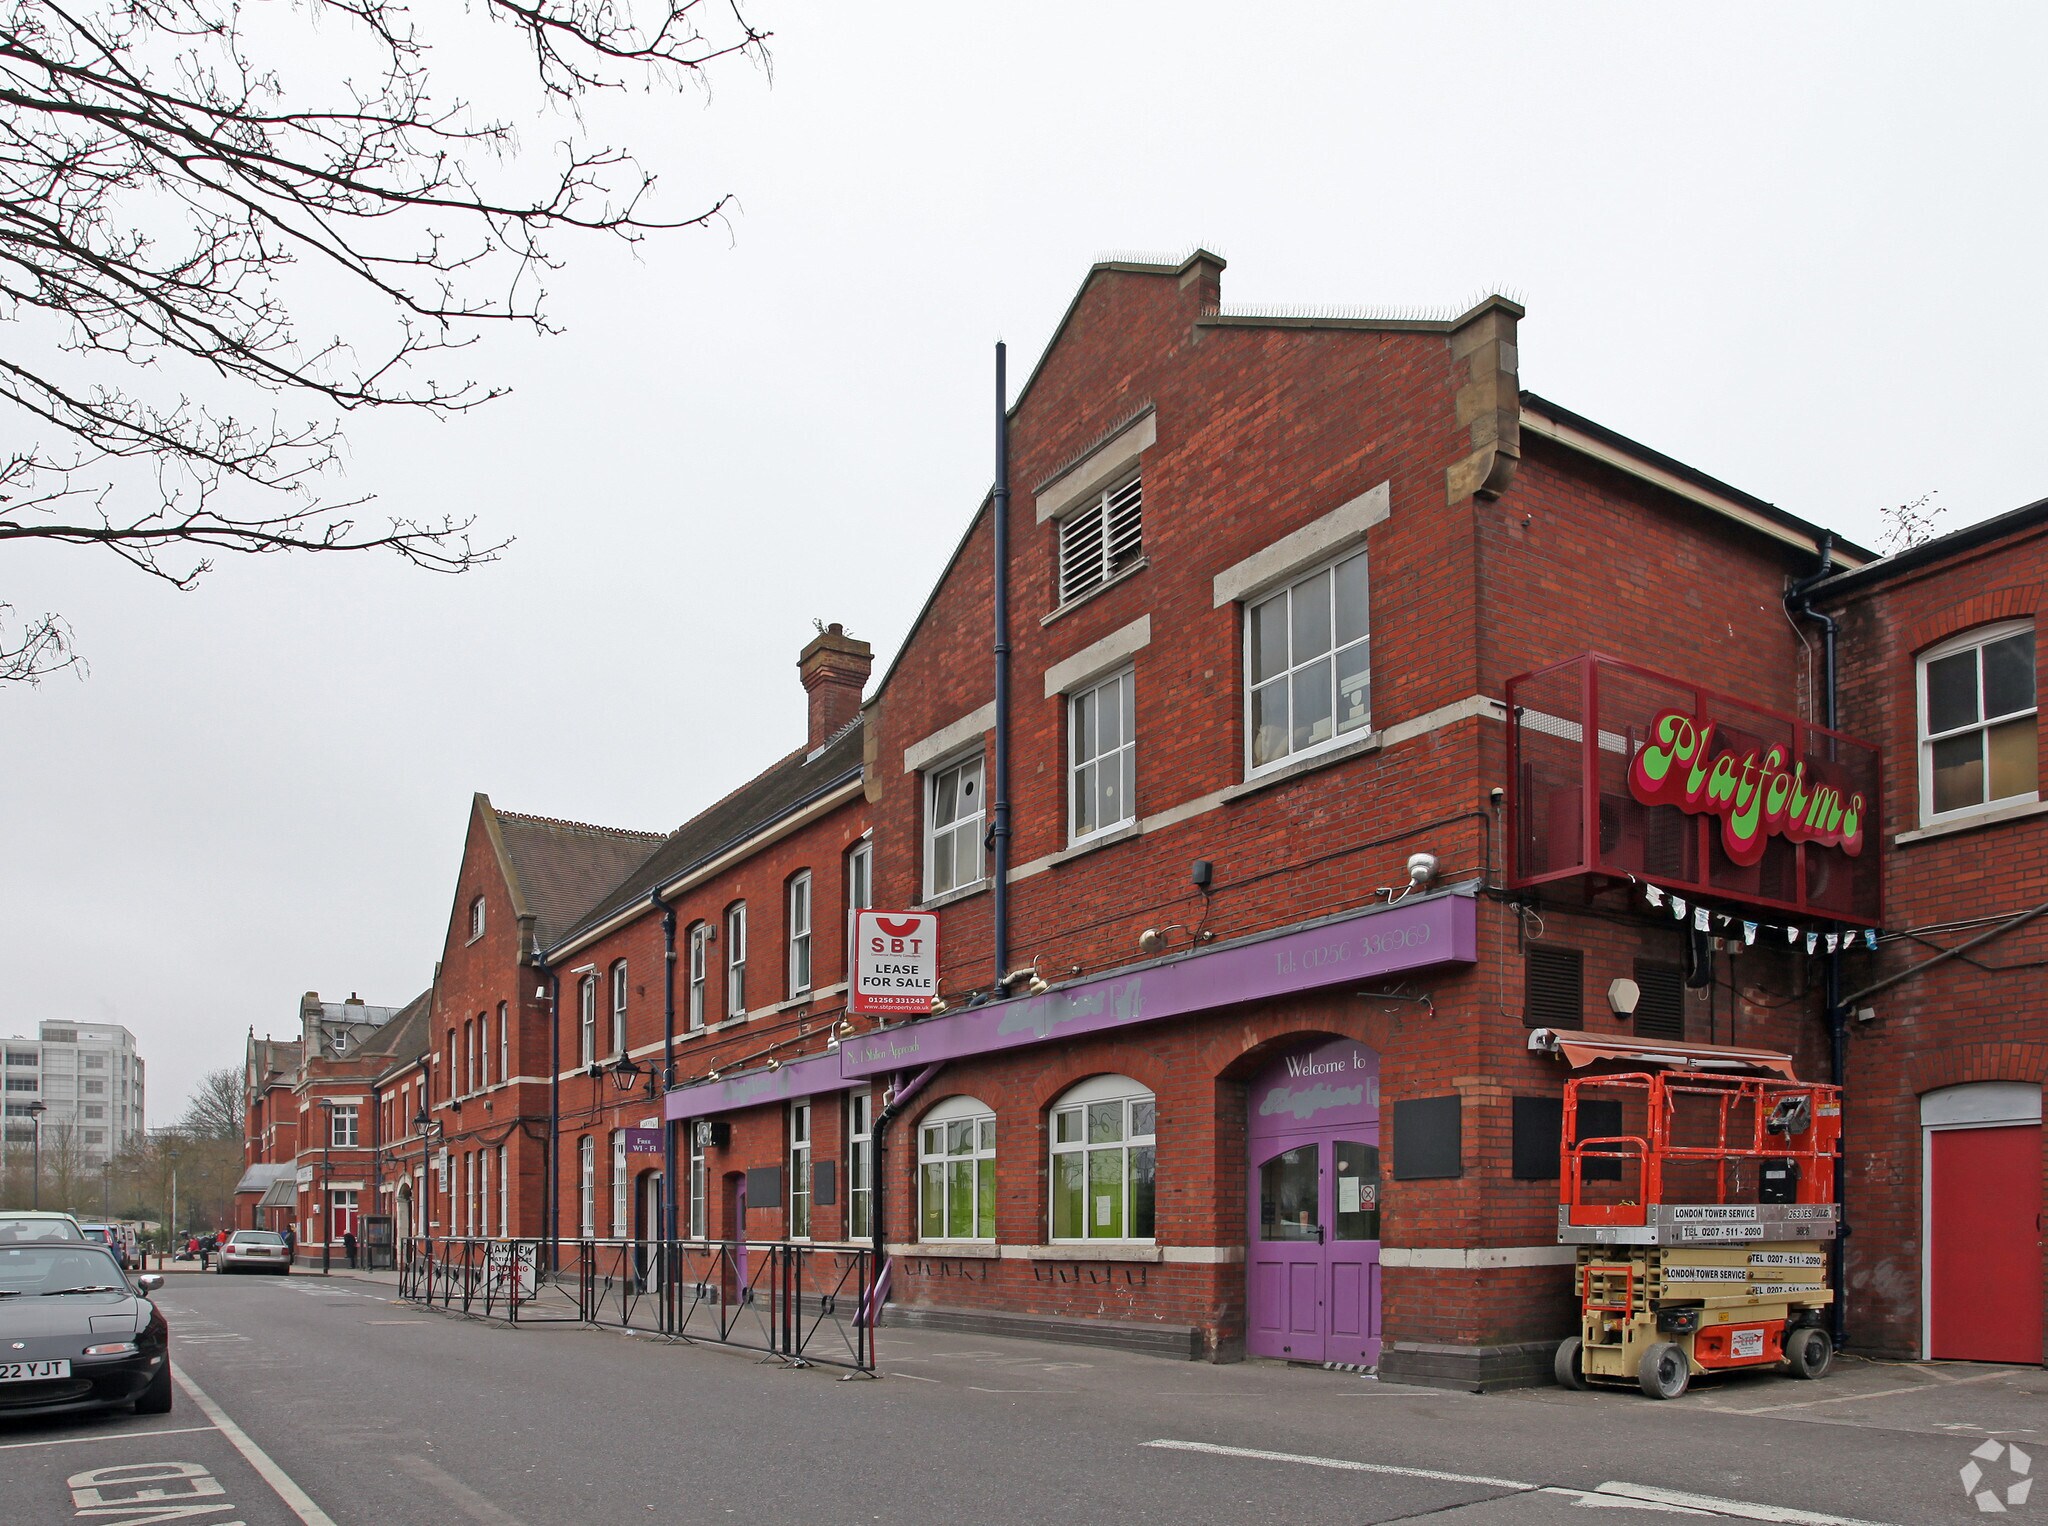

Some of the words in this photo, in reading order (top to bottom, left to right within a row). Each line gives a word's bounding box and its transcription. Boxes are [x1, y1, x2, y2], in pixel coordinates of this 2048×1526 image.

[1642, 714, 1862, 840] Platforms
[871, 937, 923, 955] SBT
[1275, 951, 1297, 976] Tel:
[1303, 941, 1350, 969] 01256
[1361, 923, 1431, 958] 336969
[875, 964, 919, 974] LEASE
[863, 977, 892, 987] FOR
[896, 978, 931, 988] SALE
[888, 1035, 920, 1060] Approach
[1285, 1053, 1346, 1078] Welcome
[1352, 1050, 1367, 1069] to
[1675, 1208, 1703, 1218] LONDON
[1704, 1208, 1728, 1218] TOWER
[1728, 1208, 1755, 1218] SERVICE
[1684, 1227, 1698, 1237] TEL
[1702, 1227, 1720, 1237] 0207
[1725, 1227, 1738, 1236] 511
[1744, 1226, 1762, 1236] 2090
[1751, 1253, 1764, 1262] TEL
[1767, 1254, 1783, 1263] 0207
[1788, 1254, 1800, 1264] 511
[1805, 1255, 1821, 1265] 2090
[1667, 1269, 1694, 1278] LONDON
[1696, 1269, 1718, 1279] TOWER
[1719, 1269, 1746, 1279] SERVICE
[1766, 1286, 1783, 1294] 0207
[27, 1361, 62, 1377] YJT
